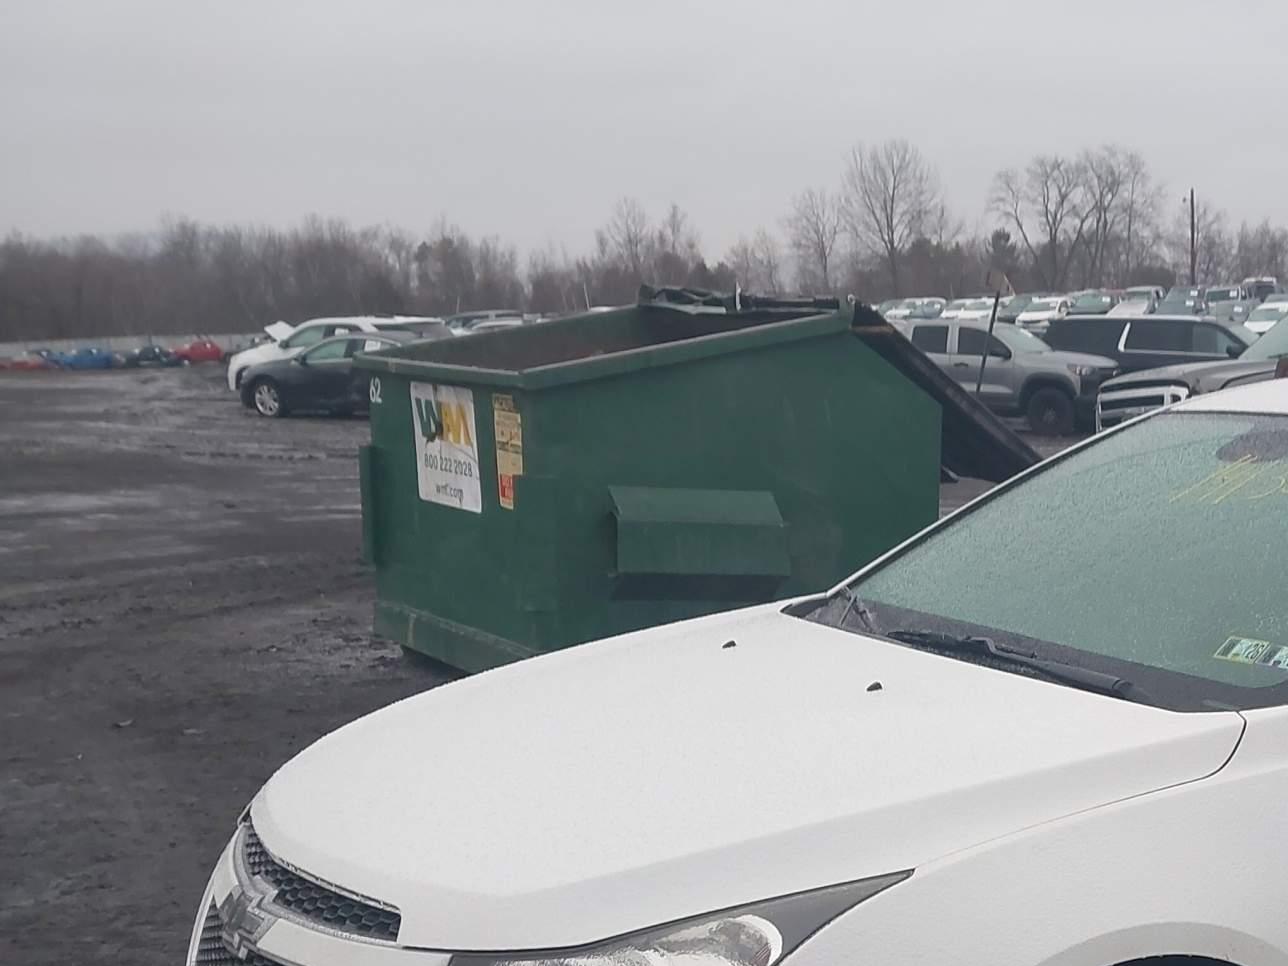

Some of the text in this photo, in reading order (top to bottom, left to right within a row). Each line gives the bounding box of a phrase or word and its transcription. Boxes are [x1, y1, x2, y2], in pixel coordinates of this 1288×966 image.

[369, 376, 383, 404] 62
[424, 453, 473, 478] 800 222 2028
